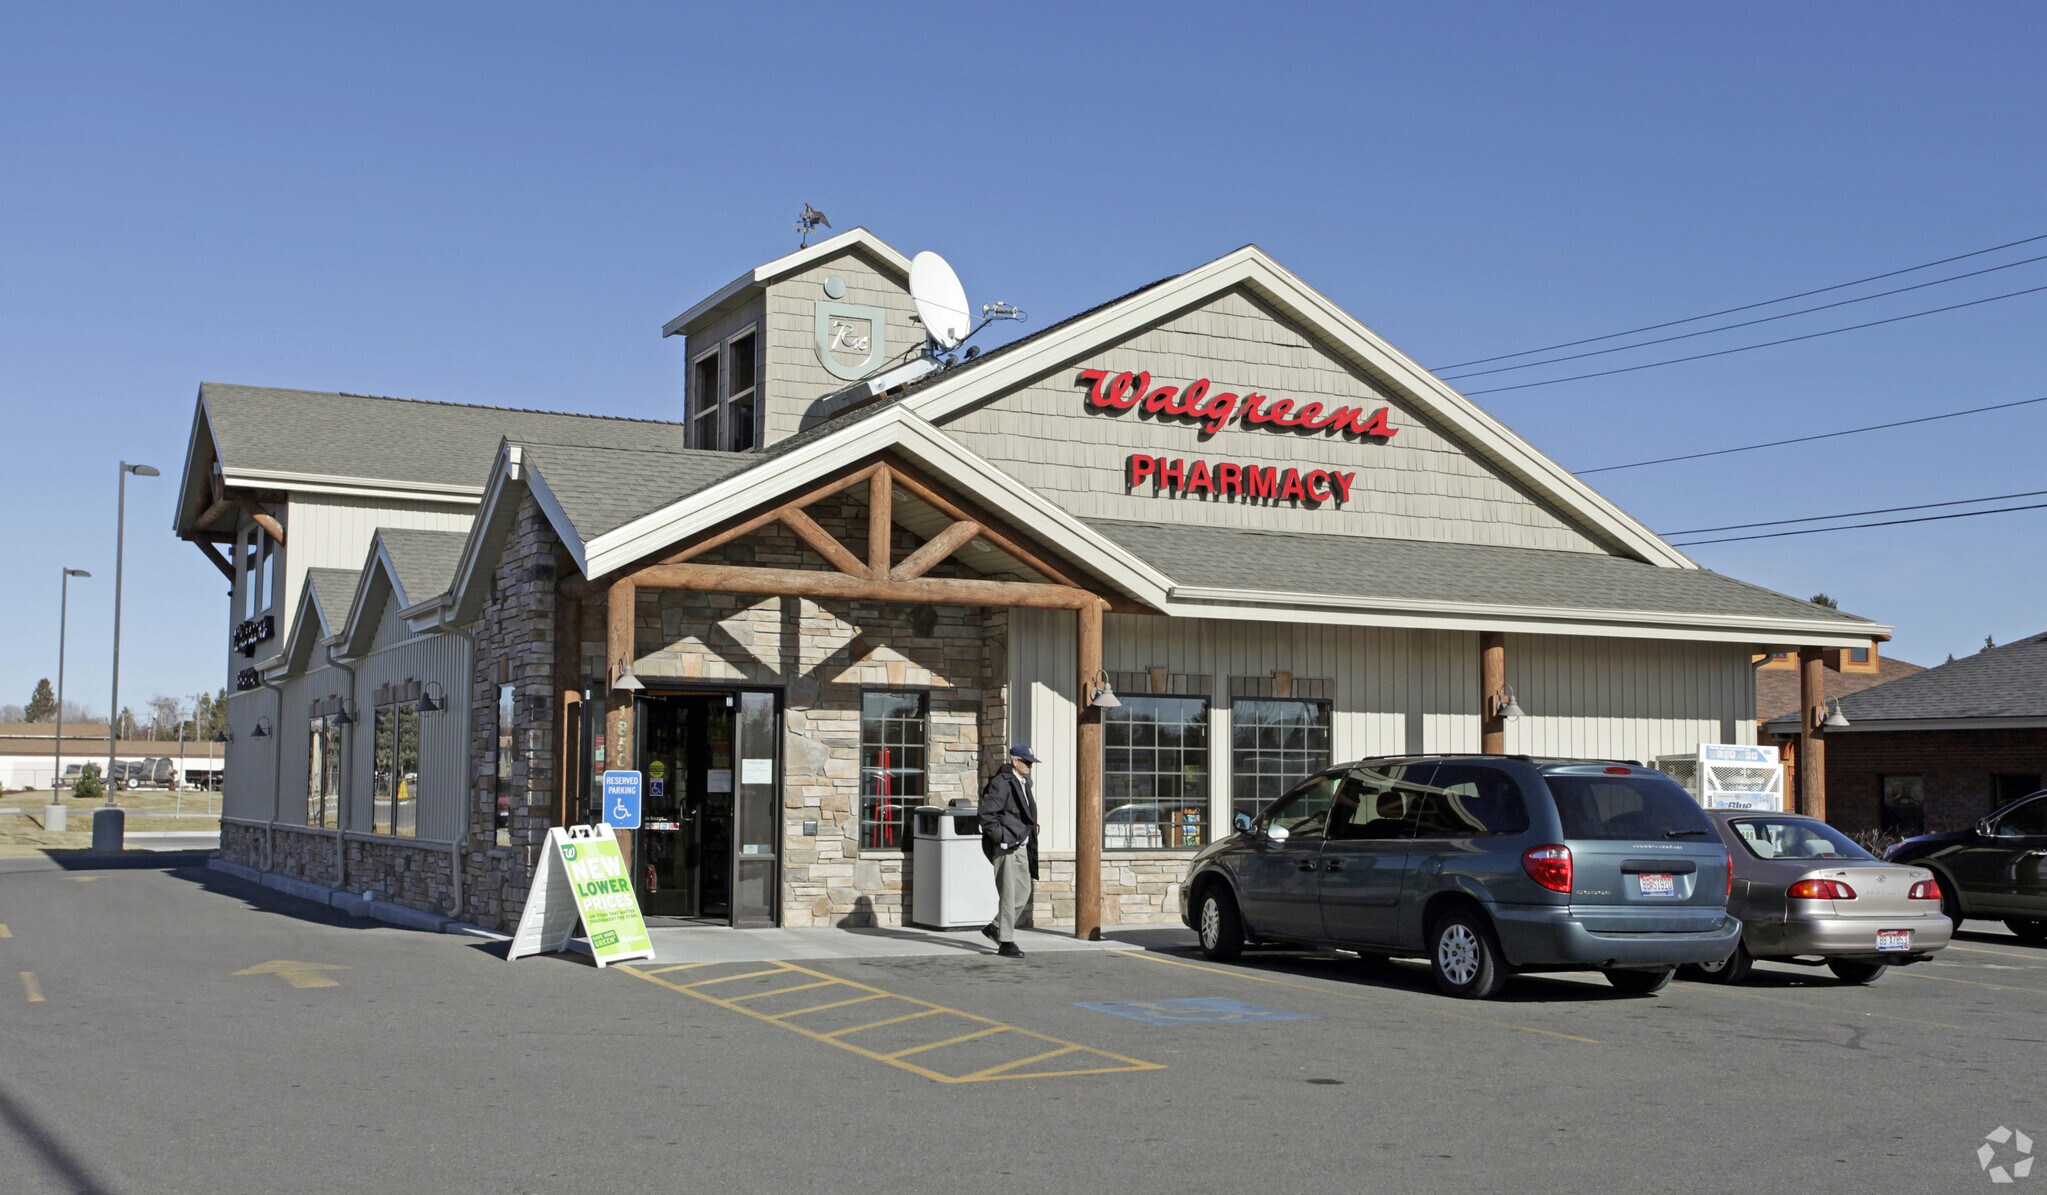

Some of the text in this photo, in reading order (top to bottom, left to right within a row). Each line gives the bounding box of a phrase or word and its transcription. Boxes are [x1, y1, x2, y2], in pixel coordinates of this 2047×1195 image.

[1080, 368, 1400, 438] Walgreens
[1131, 453, 1356, 504] PHARMACY
[606, 776, 639, 785] RESERVED
[608, 786, 637, 795] PARKING
[571, 856, 622, 880] NEW
[577, 878, 630, 897] LOWER
[581, 893, 635, 912] PRICES
